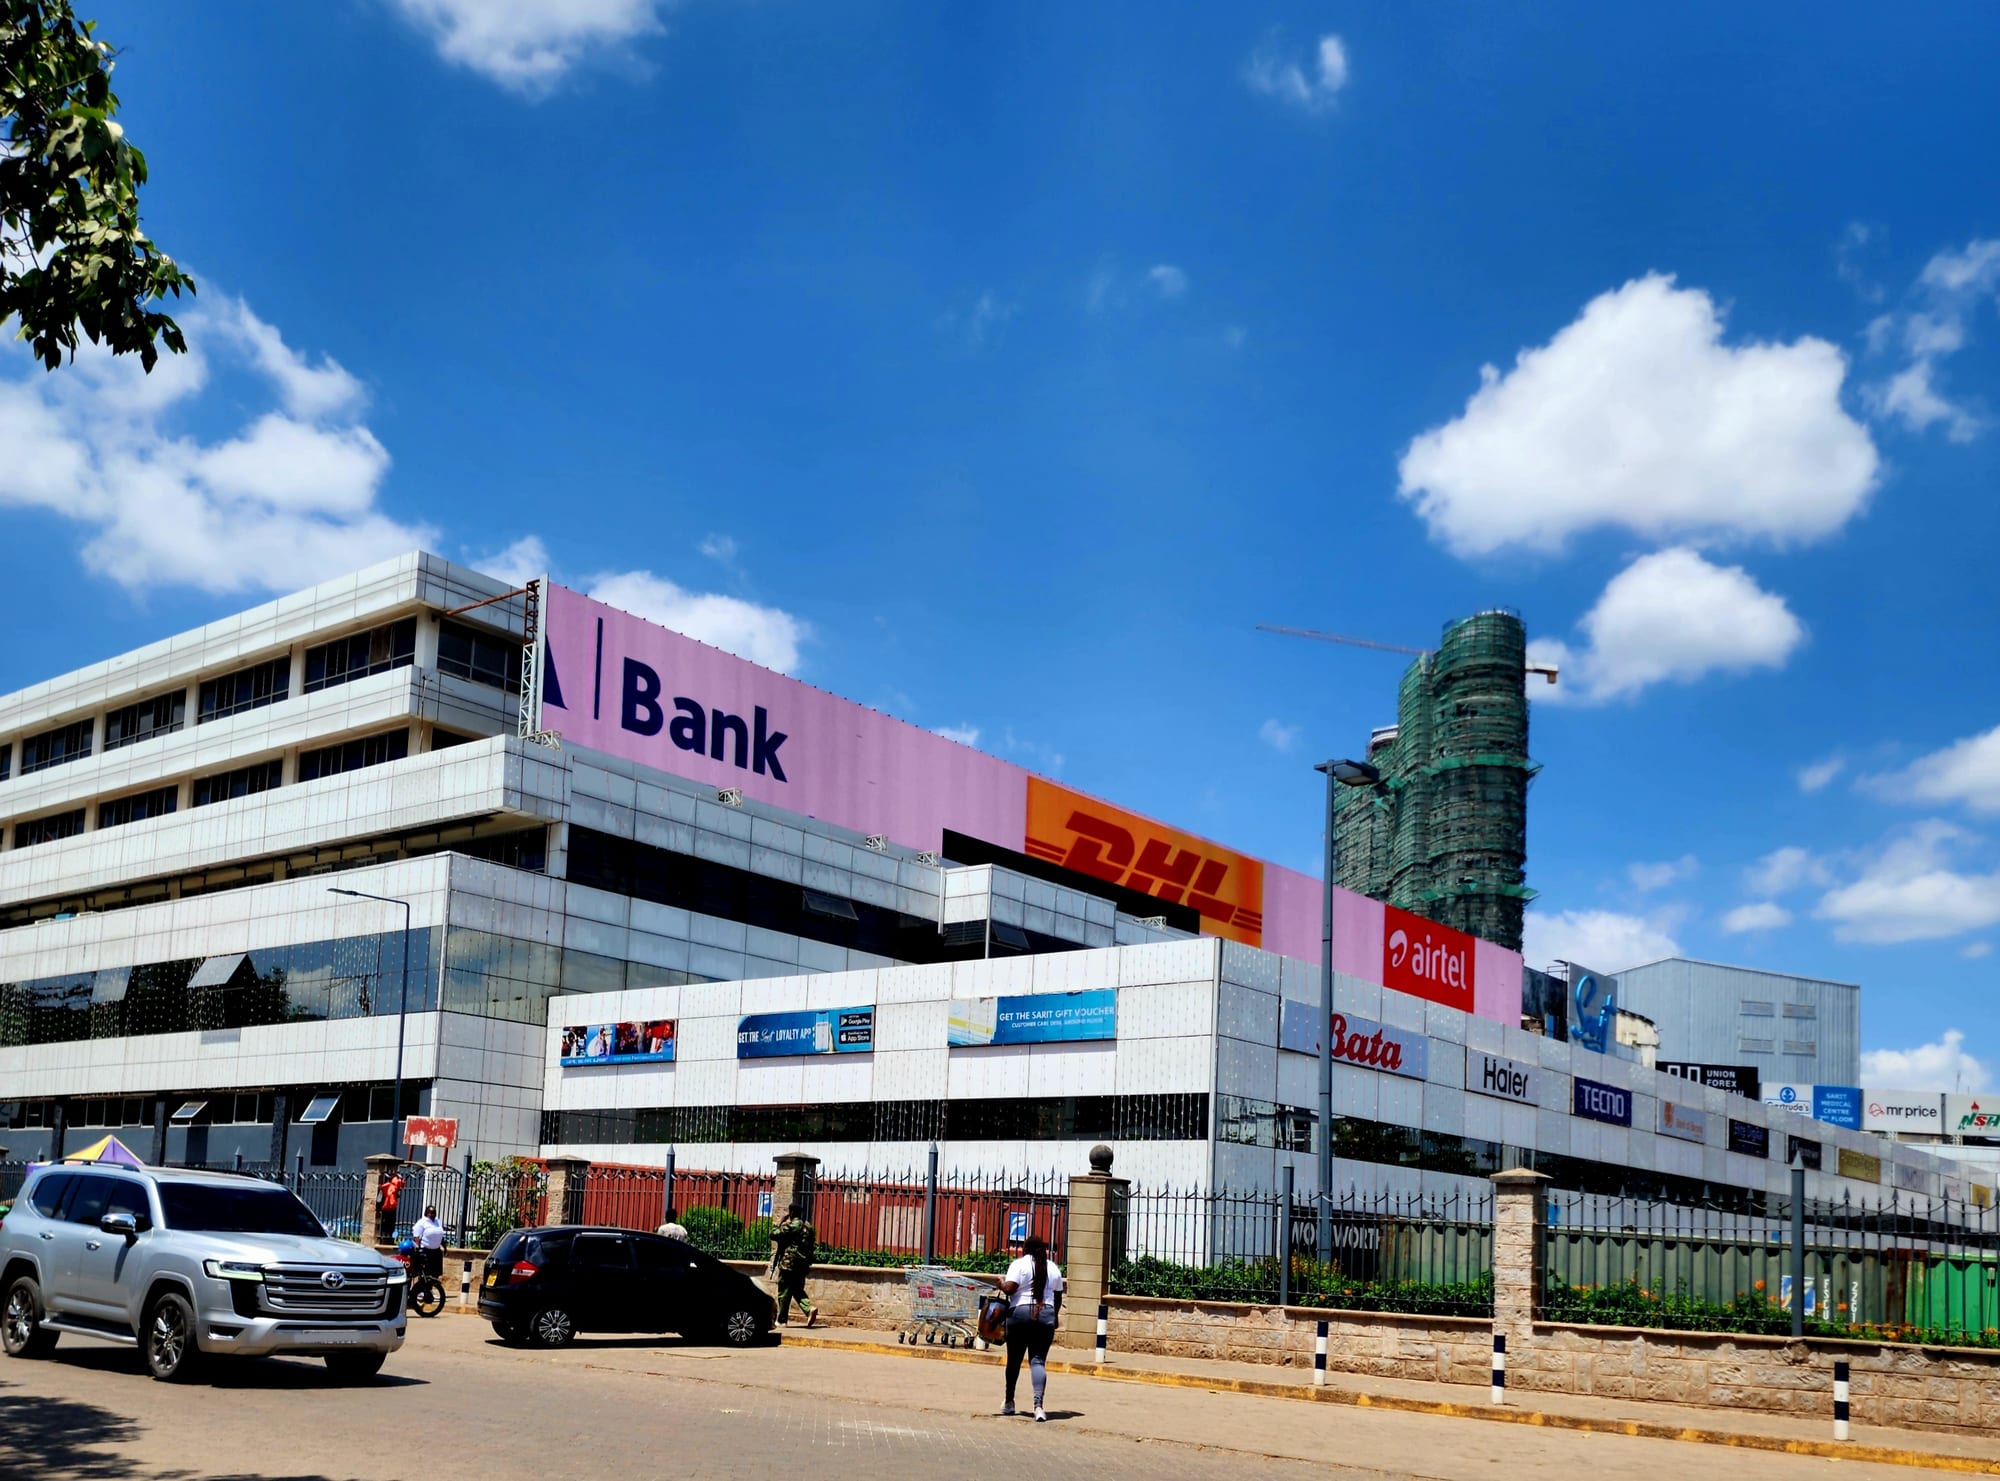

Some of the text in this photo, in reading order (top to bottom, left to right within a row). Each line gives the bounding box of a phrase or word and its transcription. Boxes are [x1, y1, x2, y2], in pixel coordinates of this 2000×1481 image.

[621, 656, 789, 783] Bank
[1063, 811, 1236, 924] DHL
[1411, 934, 1467, 990] airtel
[999, 1006, 1115, 1021] GET THE SARIT GIFT VOUCHER
[738, 1032, 748, 1044] GET
[749, 1031, 760, 1043] THE
[775, 1028, 800, 1041] LOYALTY
[1317, 1013, 1402, 1070] Bata
[1483, 1057, 1528, 1098] Haier
[1706, 1069, 1736, 1079] UNION
[1706, 1079, 1737, 1088] FOREX
[1582, 1085, 1625, 1118] TECNO
[1821, 1100, 1852, 1108] MEDICAL
[1886, 1105, 1938, 1119] mr price
